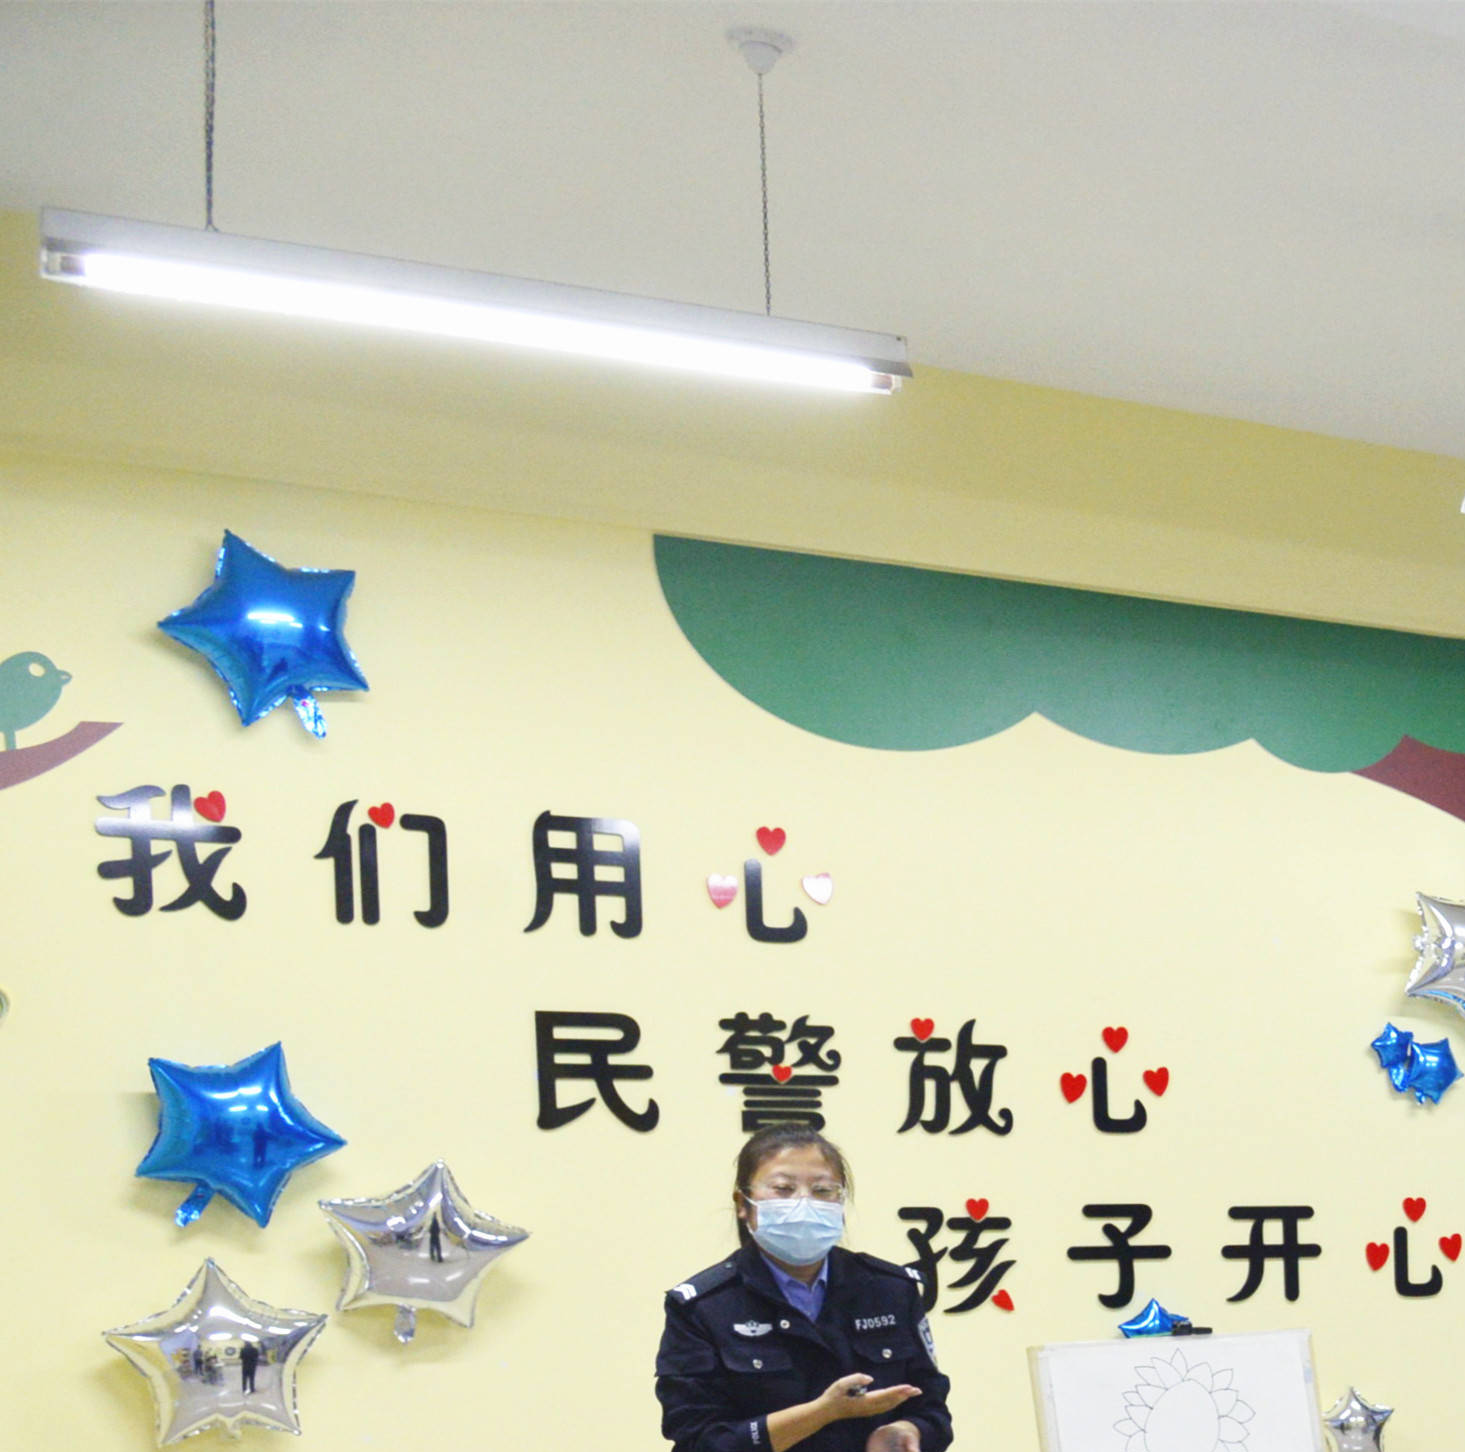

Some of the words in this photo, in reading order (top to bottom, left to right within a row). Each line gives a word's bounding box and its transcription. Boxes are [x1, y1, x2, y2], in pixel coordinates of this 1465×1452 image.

[94, 783, 834, 944] 我们用心
[534, 1010, 1170, 1138] 民警放心
[897, 1197, 1463, 1314] 孩子开心
[854, 1314, 897, 1331] FJ0592
